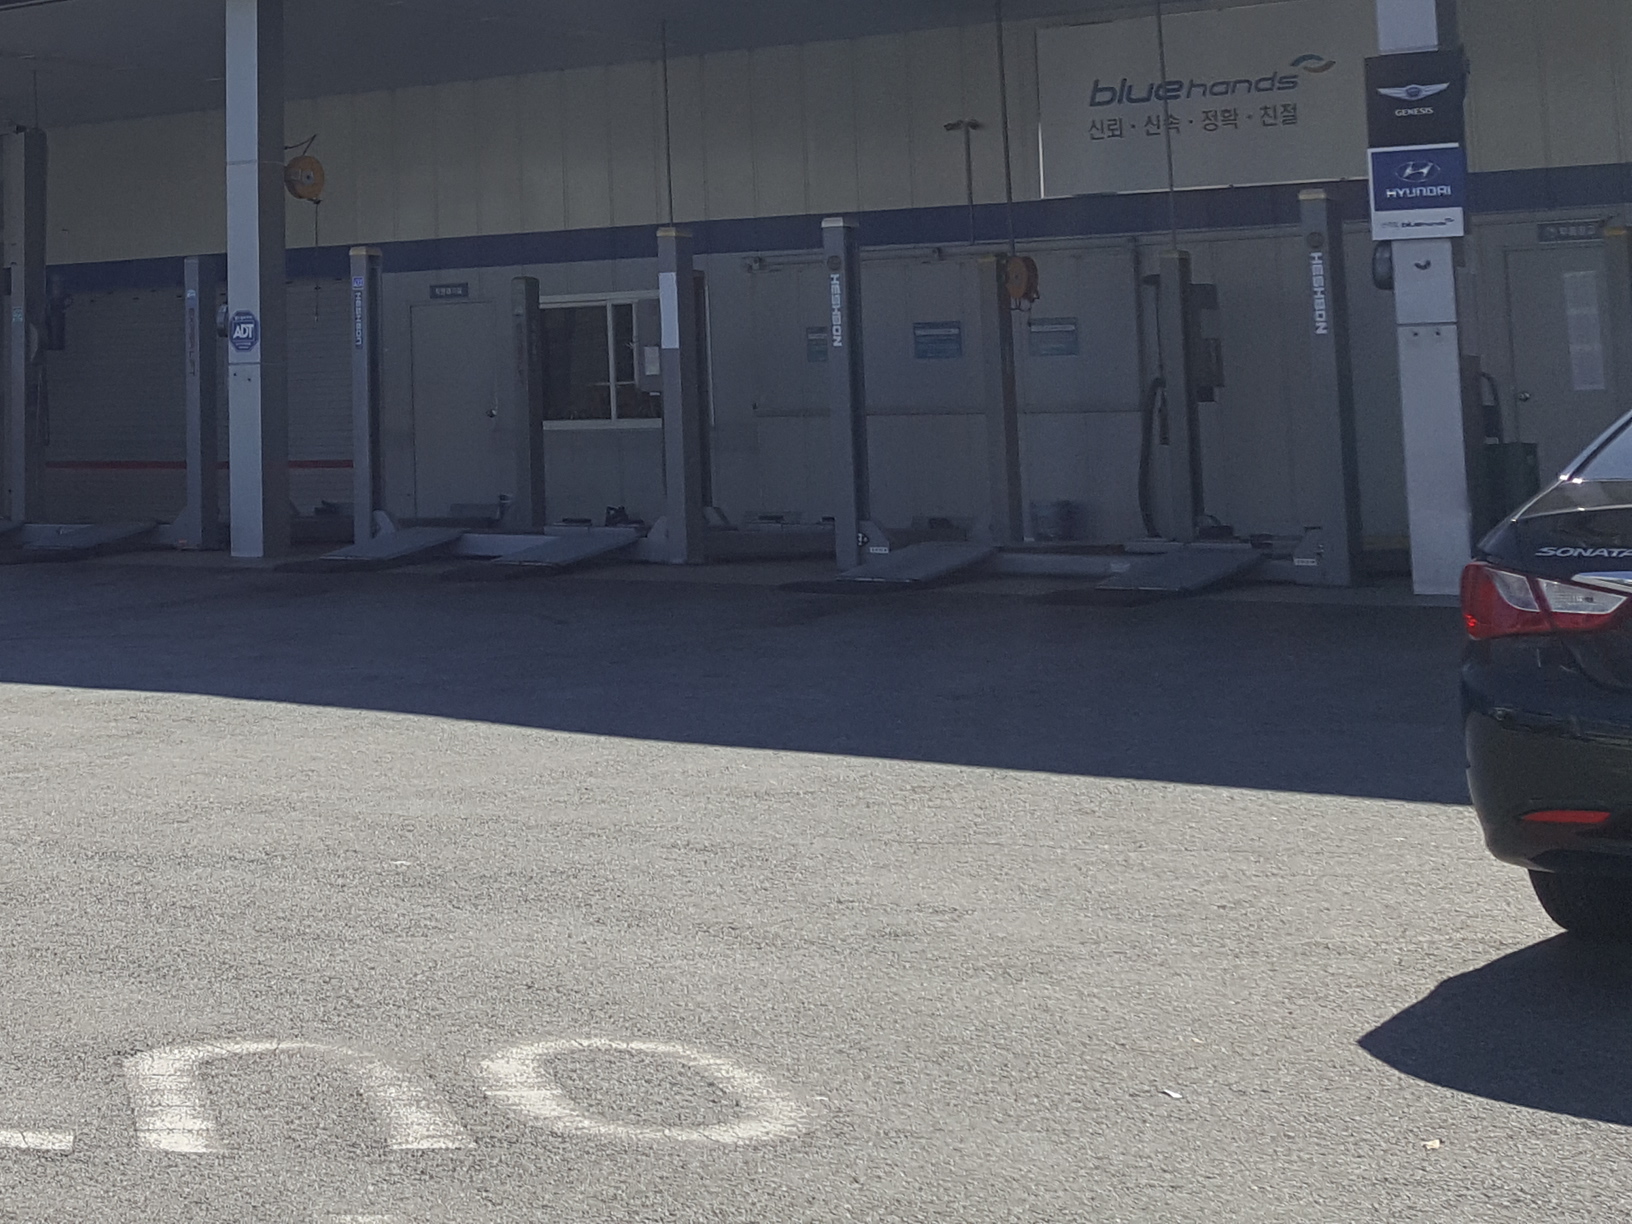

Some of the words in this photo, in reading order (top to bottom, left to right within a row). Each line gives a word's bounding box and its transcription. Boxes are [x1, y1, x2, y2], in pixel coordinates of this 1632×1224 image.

[1395, 107, 1434, 117] GENESIS
[1386, 185, 1452, 198] HYUNDAI
[830, 274, 842, 346] HESHBON
[232, 323, 255, 339] ADT
